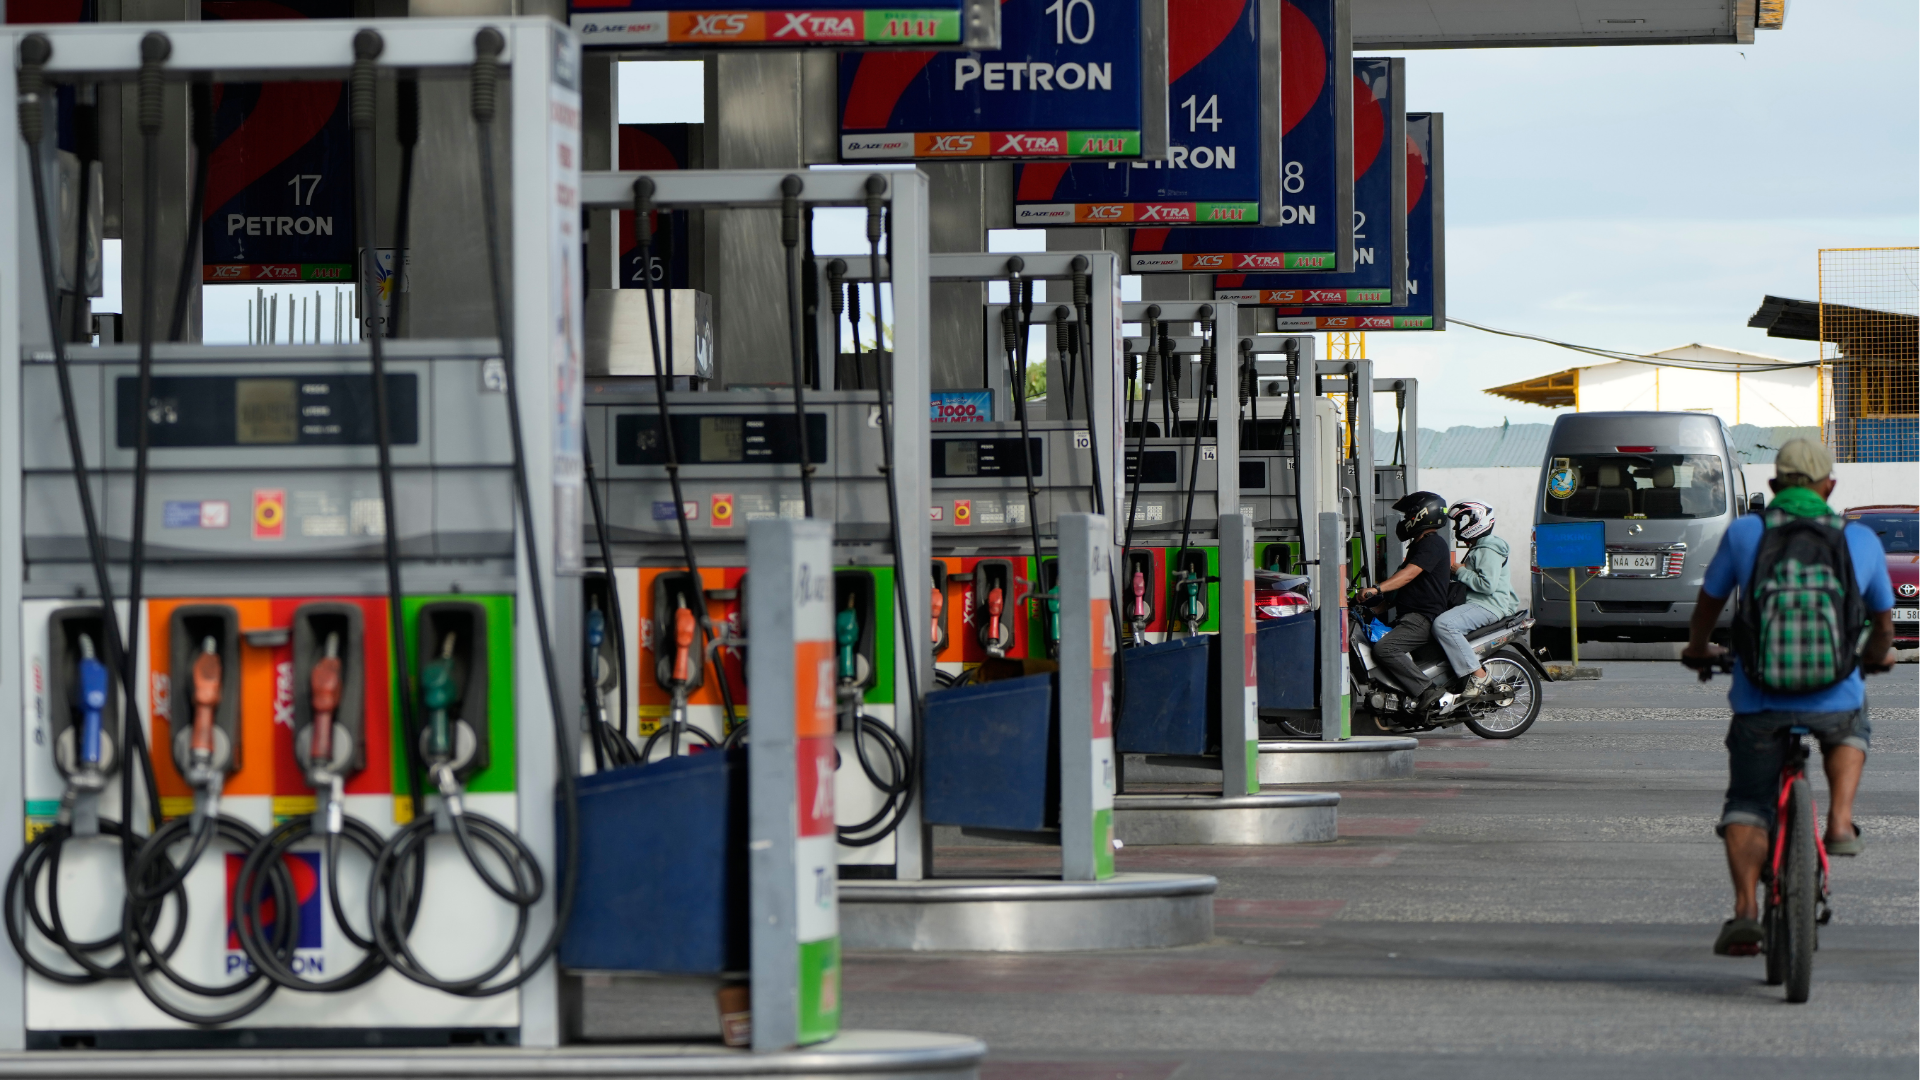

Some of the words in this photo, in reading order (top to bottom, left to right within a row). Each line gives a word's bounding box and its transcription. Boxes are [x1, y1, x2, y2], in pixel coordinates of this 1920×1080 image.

[689, 14, 748, 35] XCS
[773, 13, 855, 37] XTRA
[1045, 0, 1095, 44] 10
[955, 58, 1112, 91] PETRON
[1181, 94, 1223, 133] 14
[930, 135, 975, 151] XCS
[997, 134, 1059, 152] XTRA
[287, 174, 323, 206] 17
[1087, 205, 1124, 219] XCS
[1139, 205, 1190, 220] XTRA
[227, 213, 333, 236] PETRON
[631, 256, 664, 281] 25
[1193, 255, 1224, 266] XCS
[1237, 254, 1280, 267] XTRA
[212, 266, 243, 277] XCS
[256, 266, 298, 278] XTRA
[1268, 291, 1296, 301] XCS
[1305, 290, 1342, 302] XTRA
[1324, 317, 1349, 326] XCS
[1359, 317, 1391, 327] XTRA
[938, 404, 977, 417] 1000
[1076, 438, 1089, 448] 10
[1203, 452, 1215, 460] 14
[1614, 558, 1629, 567] NAA
[1634, 558, 1655, 567] 6247
[963, 591, 975, 628] XTRA
[273, 662, 296, 729] XTRA
[226, 955, 324, 975] PEON
